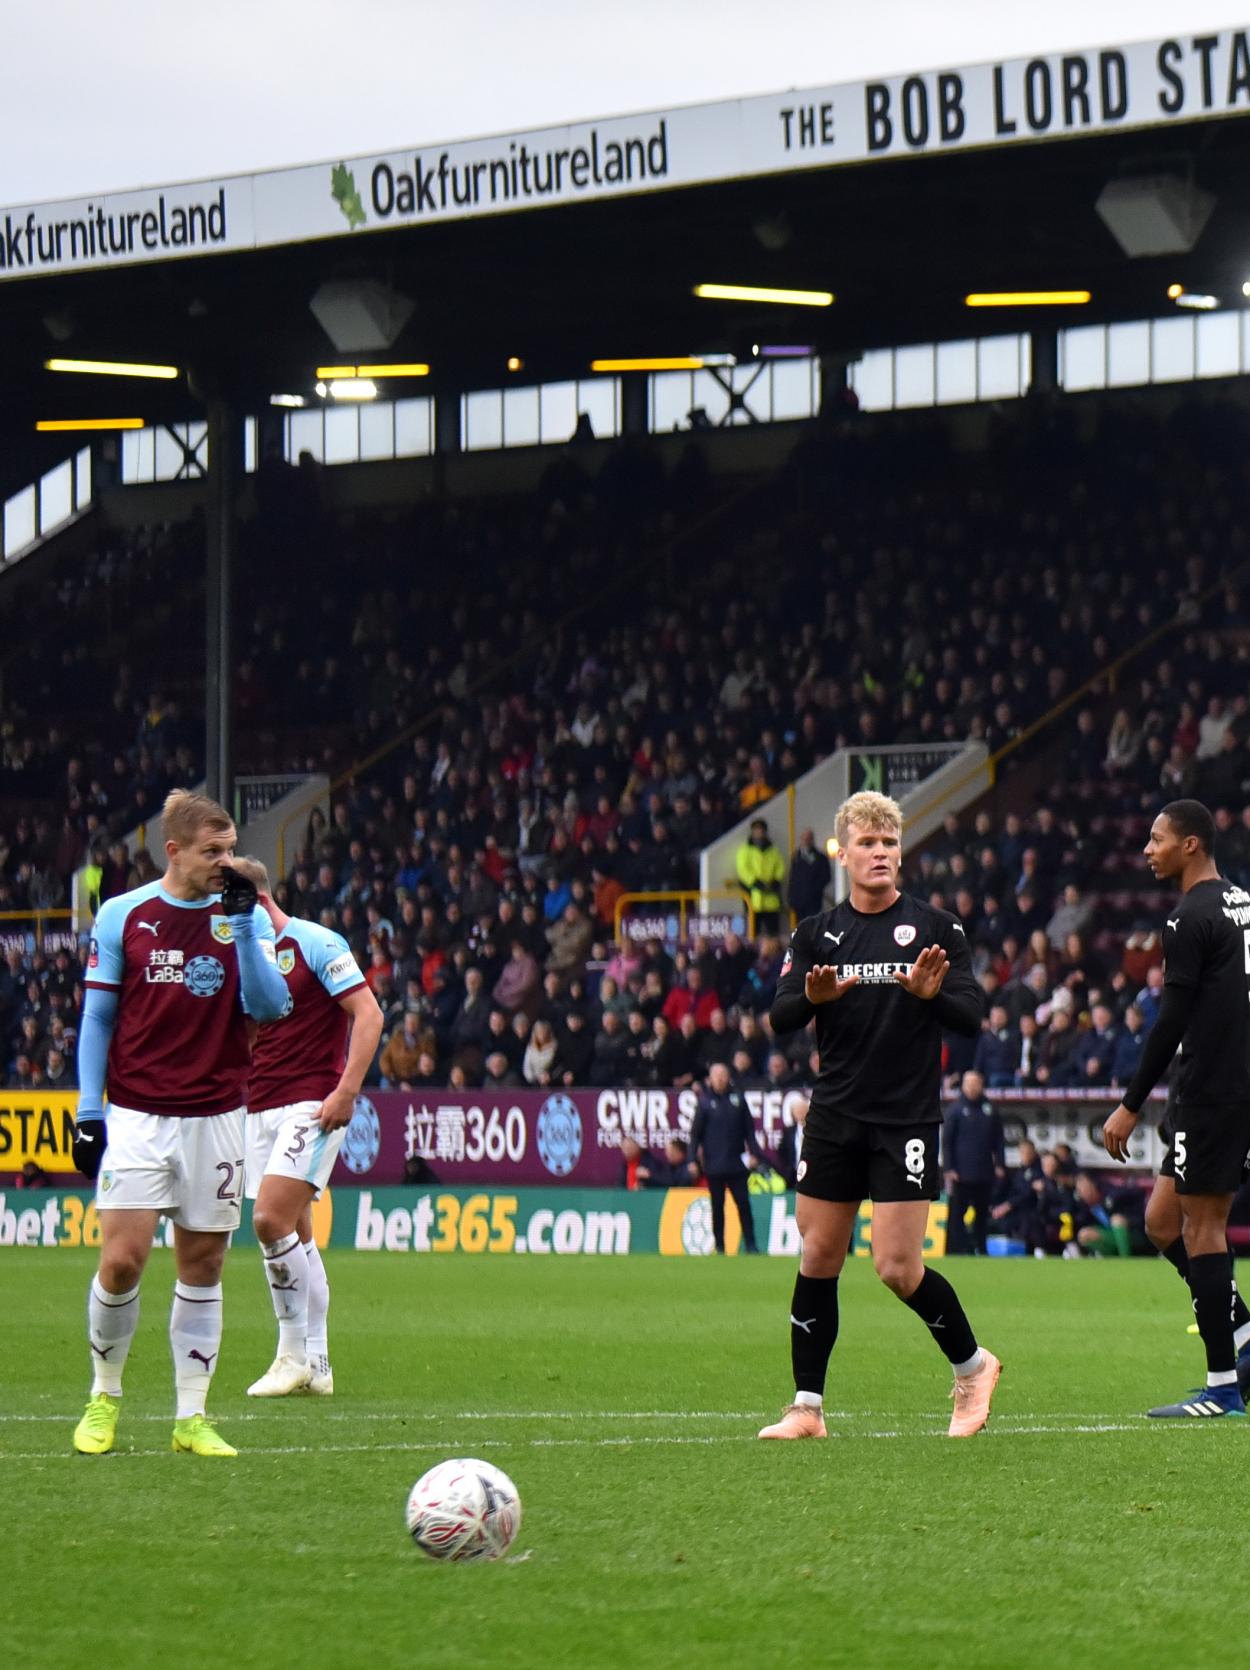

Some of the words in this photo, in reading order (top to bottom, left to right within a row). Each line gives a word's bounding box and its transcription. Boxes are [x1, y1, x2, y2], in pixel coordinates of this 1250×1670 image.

[780, 102, 835, 151] THE
[865, 74, 967, 152] BOB
[994, 50, 1130, 136] LORD
[371, 117, 669, 217] Oakfurnitureland
[145, 966, 184, 983] LaBa
[194, 971, 216, 982] 360
[149, 949, 184, 966] 拉霸
[597, 1089, 670, 1133] CWR
[288, 1125, 310, 1154] 3
[404, 1104, 527, 1163] 拉霸360
[1174, 1131, 1187, 1166] 5
[905, 1138, 925, 1174] 8
[355, 1190, 631, 1255] bet365.com
